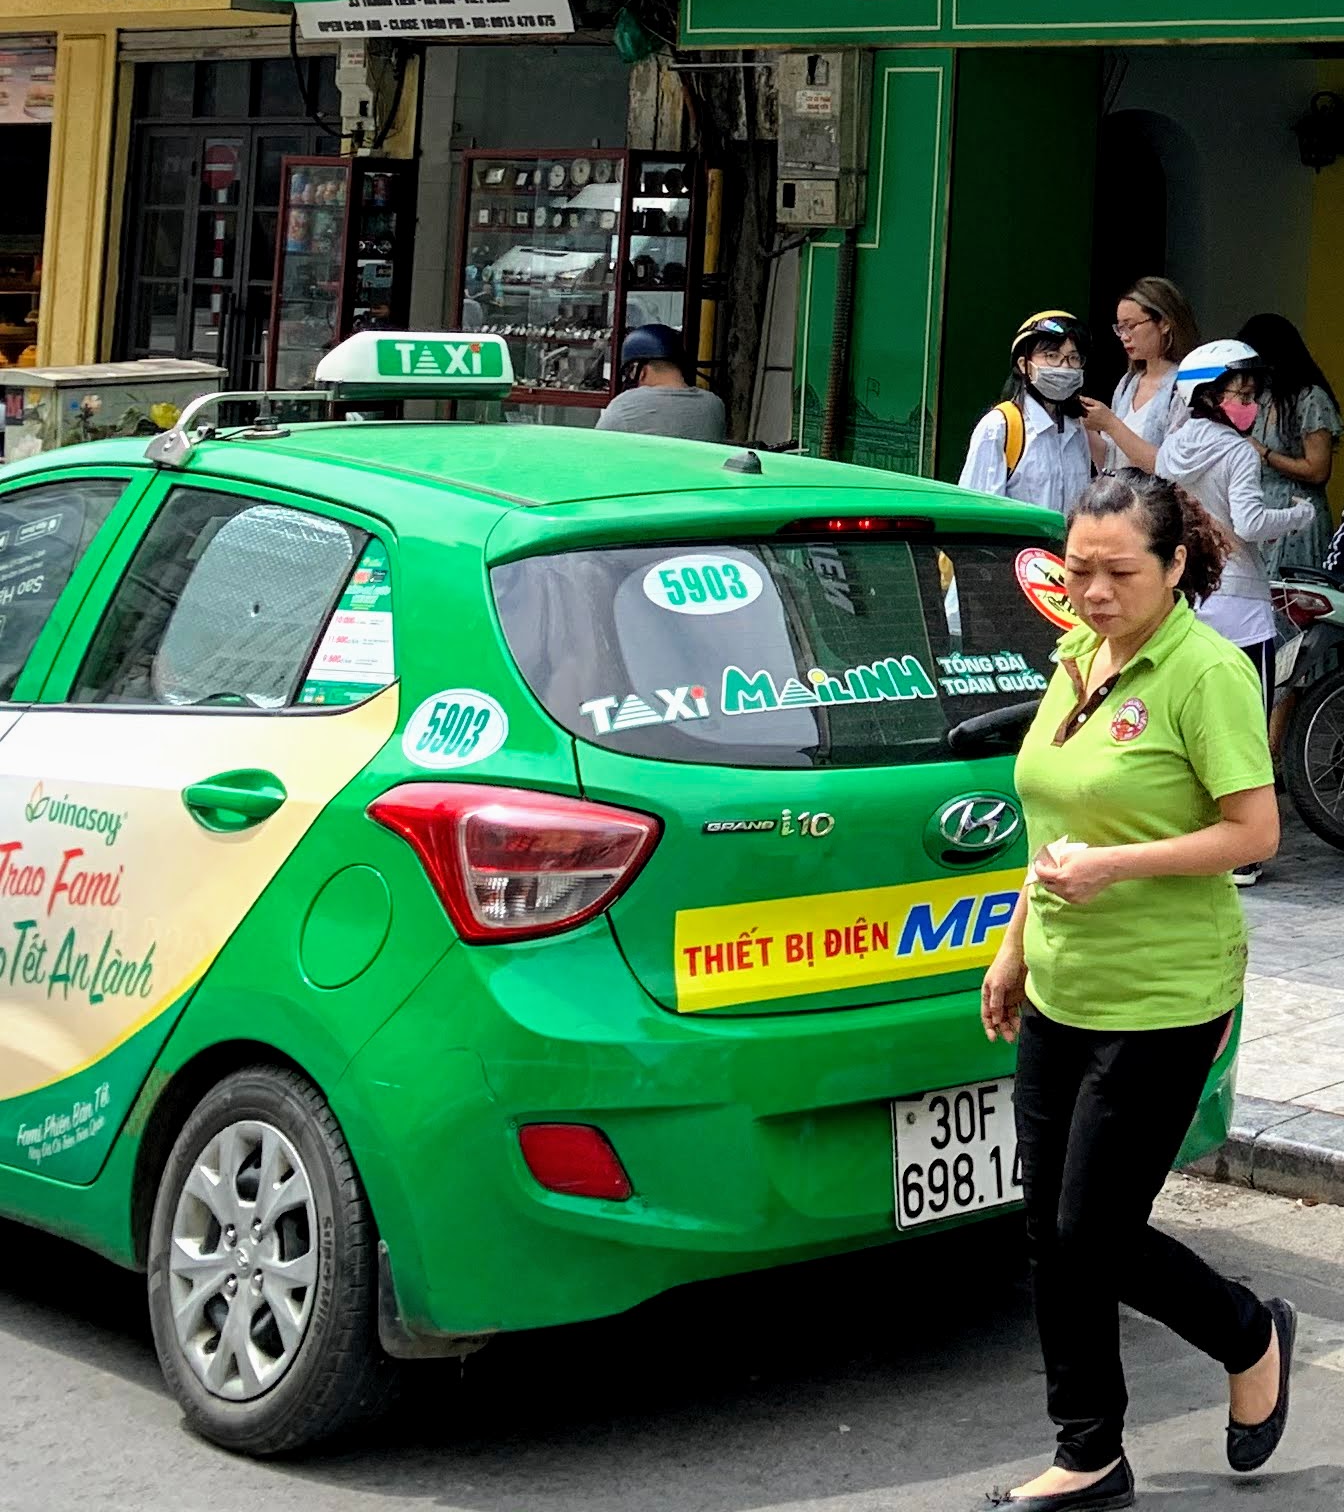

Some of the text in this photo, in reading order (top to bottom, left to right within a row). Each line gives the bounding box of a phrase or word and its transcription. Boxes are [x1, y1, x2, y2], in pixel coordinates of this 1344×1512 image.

[659, 564, 748, 605] 5903
[416, 702, 491, 757] 5903
[706, 820, 775, 834] GRAND
[47, 848, 123, 916] Fami
[10, 920, 46, 986] Tết
[48, 926, 90, 1000] An
[90, 929, 156, 1004] Lành
[683, 926, 774, 977] THIẾT
[786, 932, 814, 967] BỊ
[824, 917, 890, 959] ĐIỆN
[929, 1085, 998, 1149] 30F
